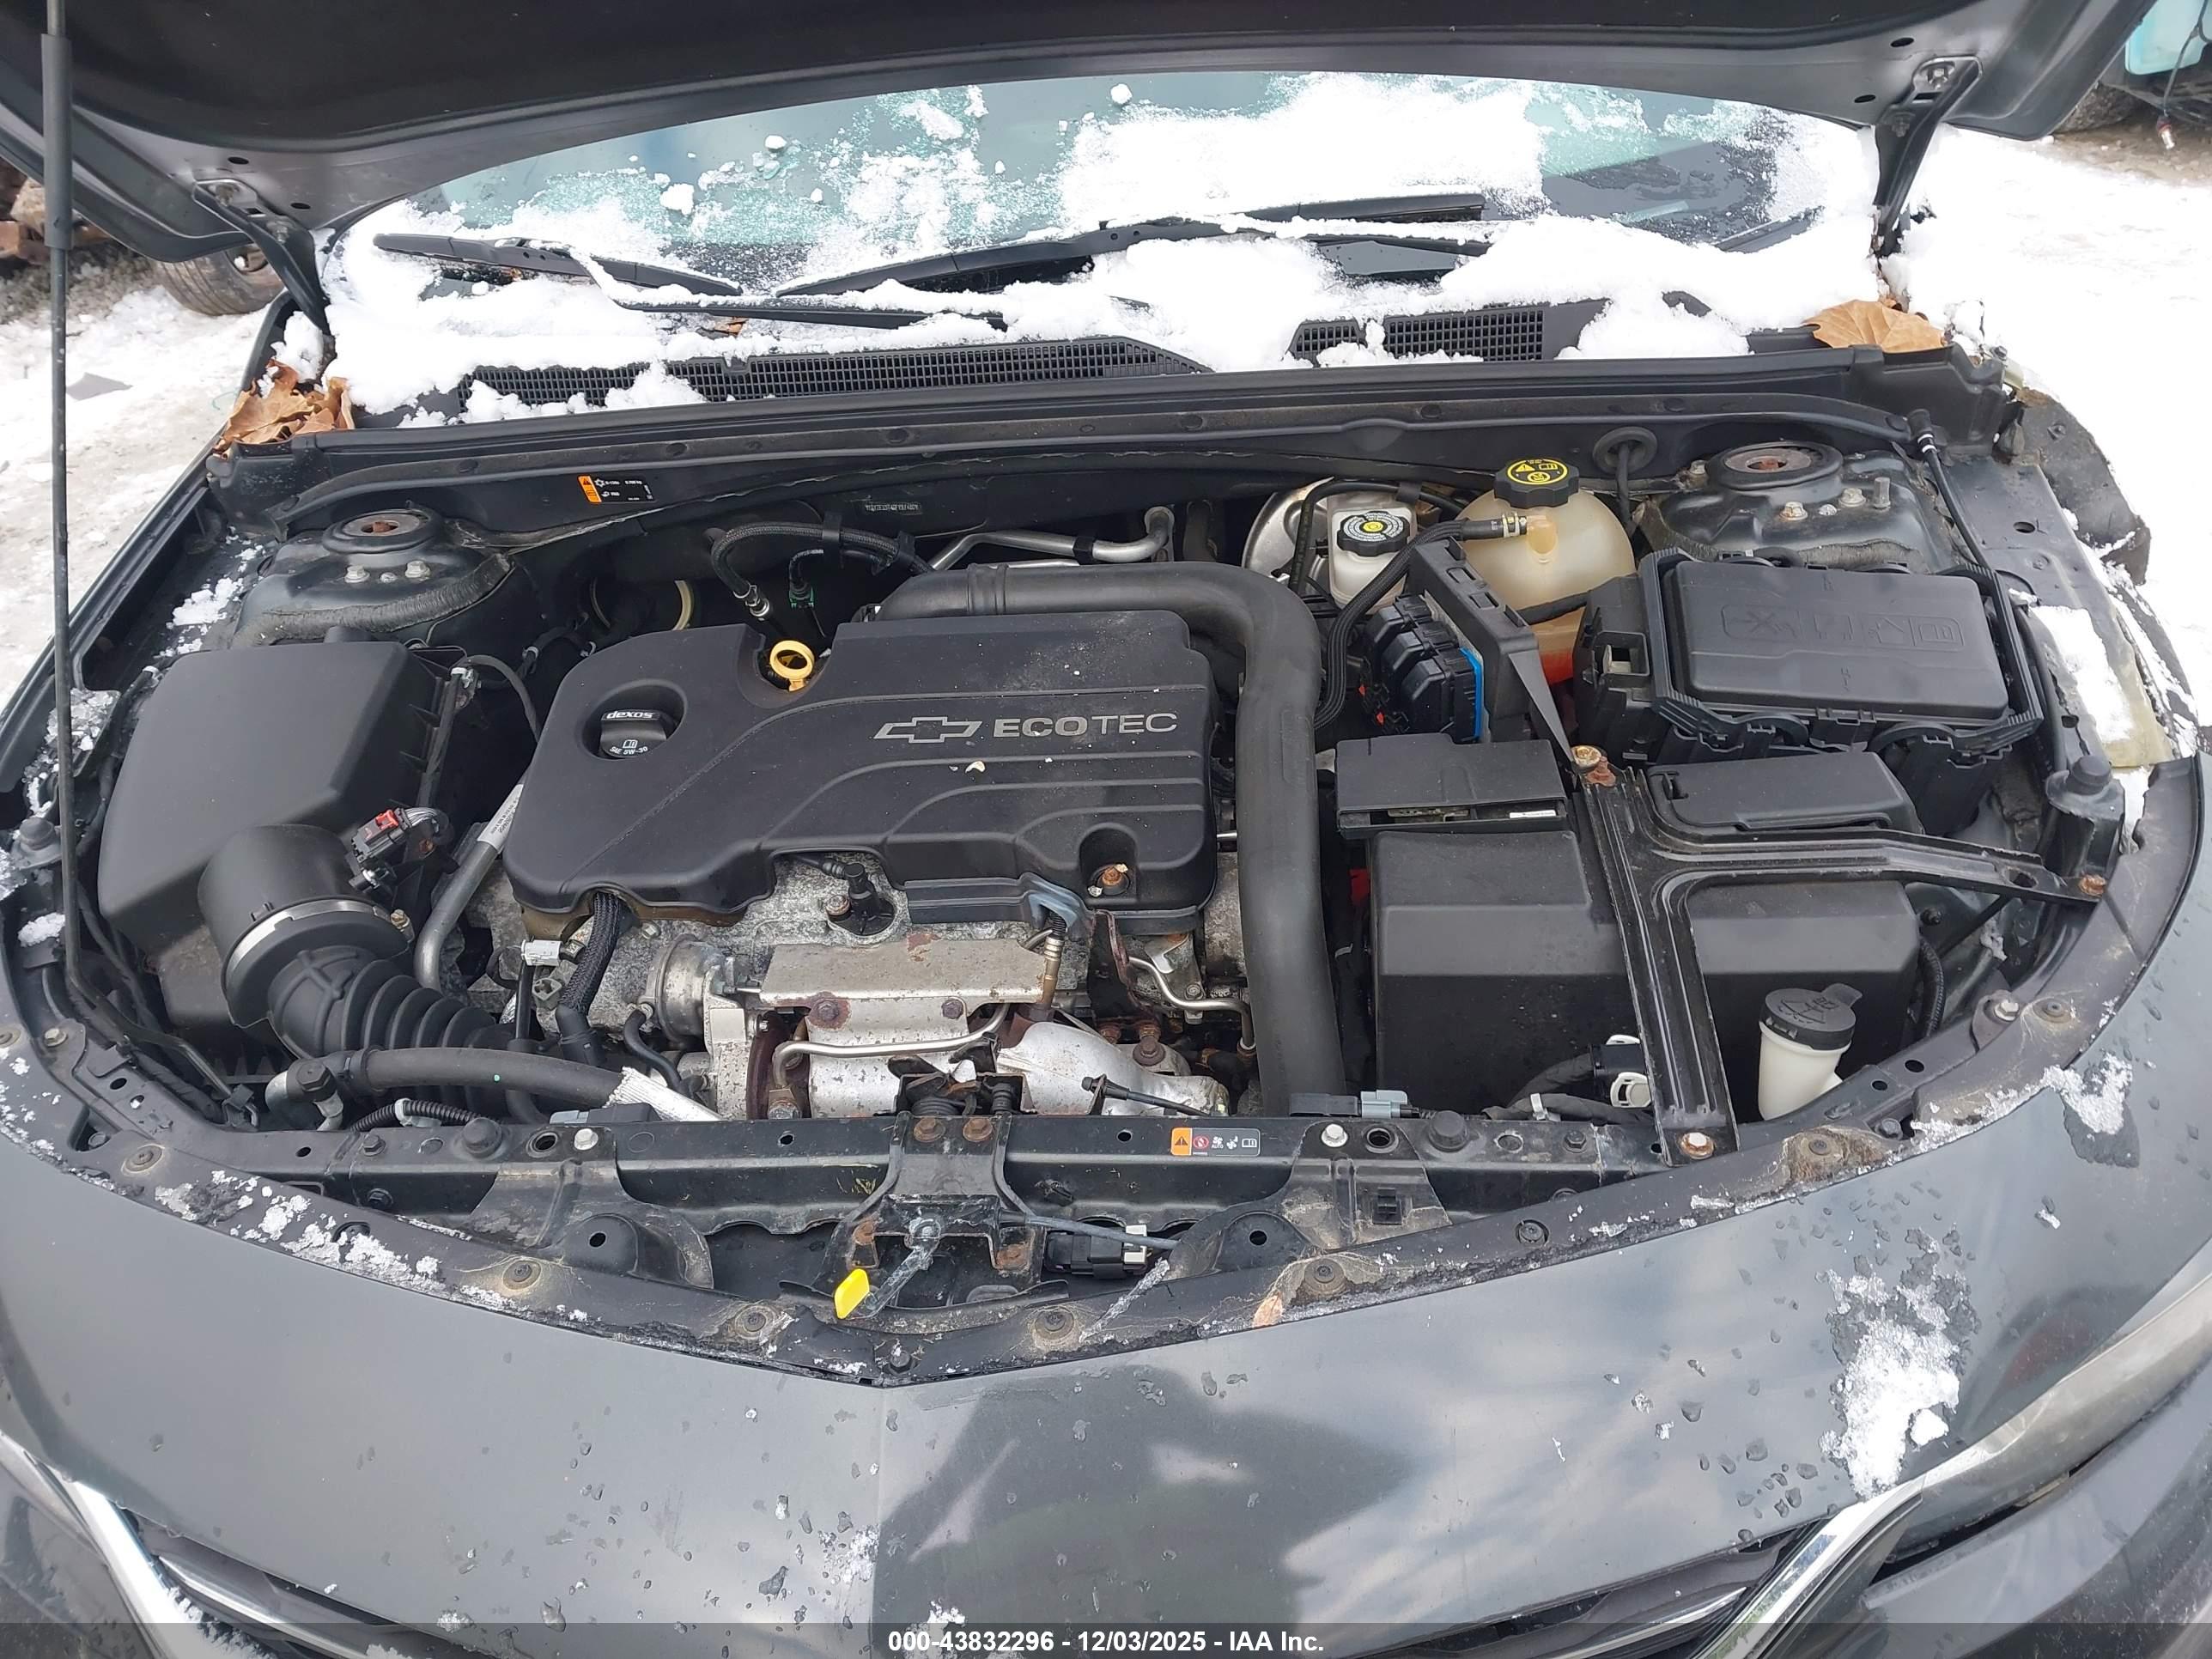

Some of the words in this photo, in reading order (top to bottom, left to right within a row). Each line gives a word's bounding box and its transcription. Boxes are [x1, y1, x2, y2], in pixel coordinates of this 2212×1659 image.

[606, 710, 653, 719] dexos
[993, 713, 1178, 738] ECOTEC
[609, 746, 623, 755] SAE
[623, 745, 648, 755] 5W-30
